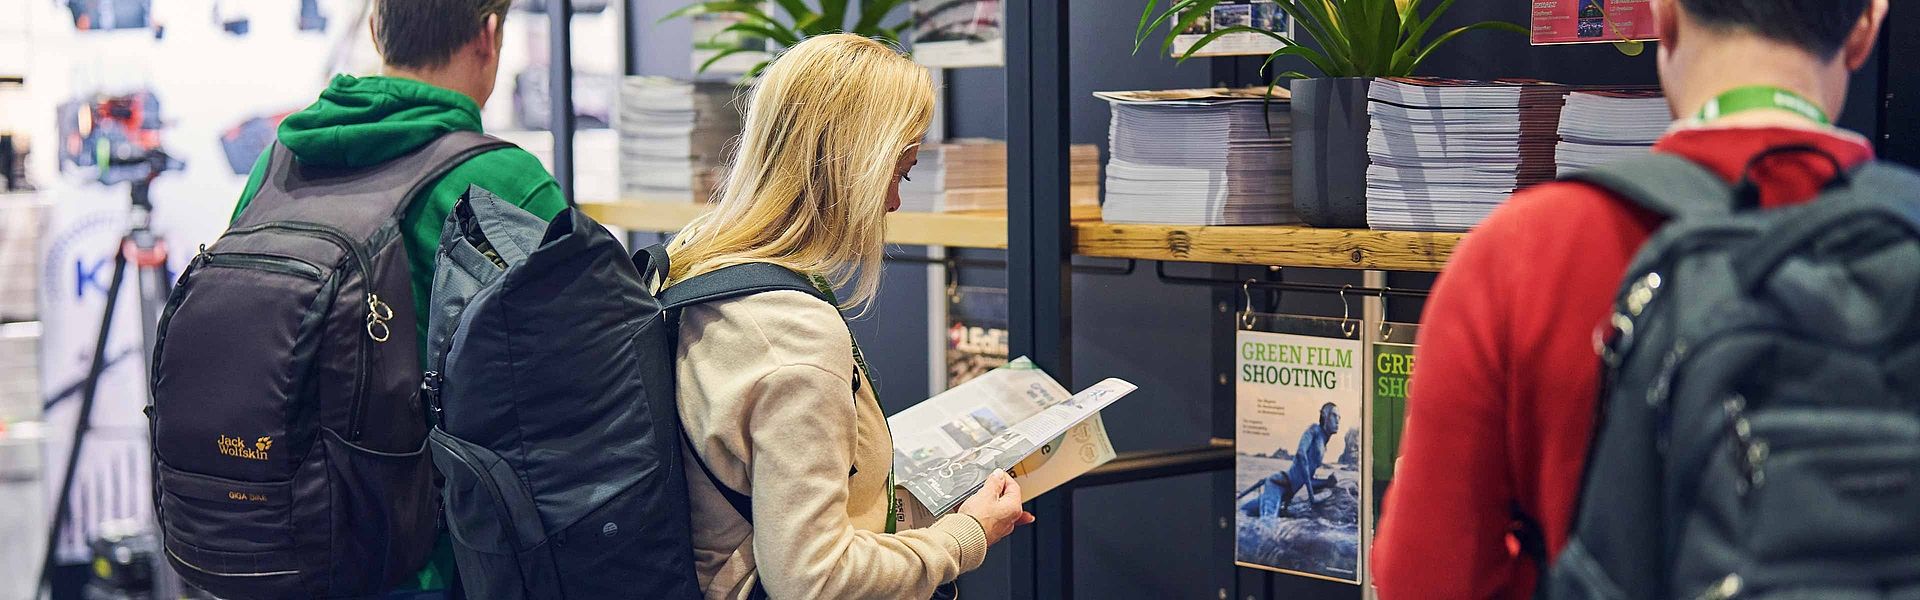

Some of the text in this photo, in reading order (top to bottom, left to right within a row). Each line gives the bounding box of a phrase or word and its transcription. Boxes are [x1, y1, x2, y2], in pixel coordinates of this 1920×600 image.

[1242, 341, 1353, 368] GREEN FILM
[1243, 363, 1337, 389] SHOOTING
[217, 434, 246, 448] Jack
[218, 443, 268, 460] Wolfskin
